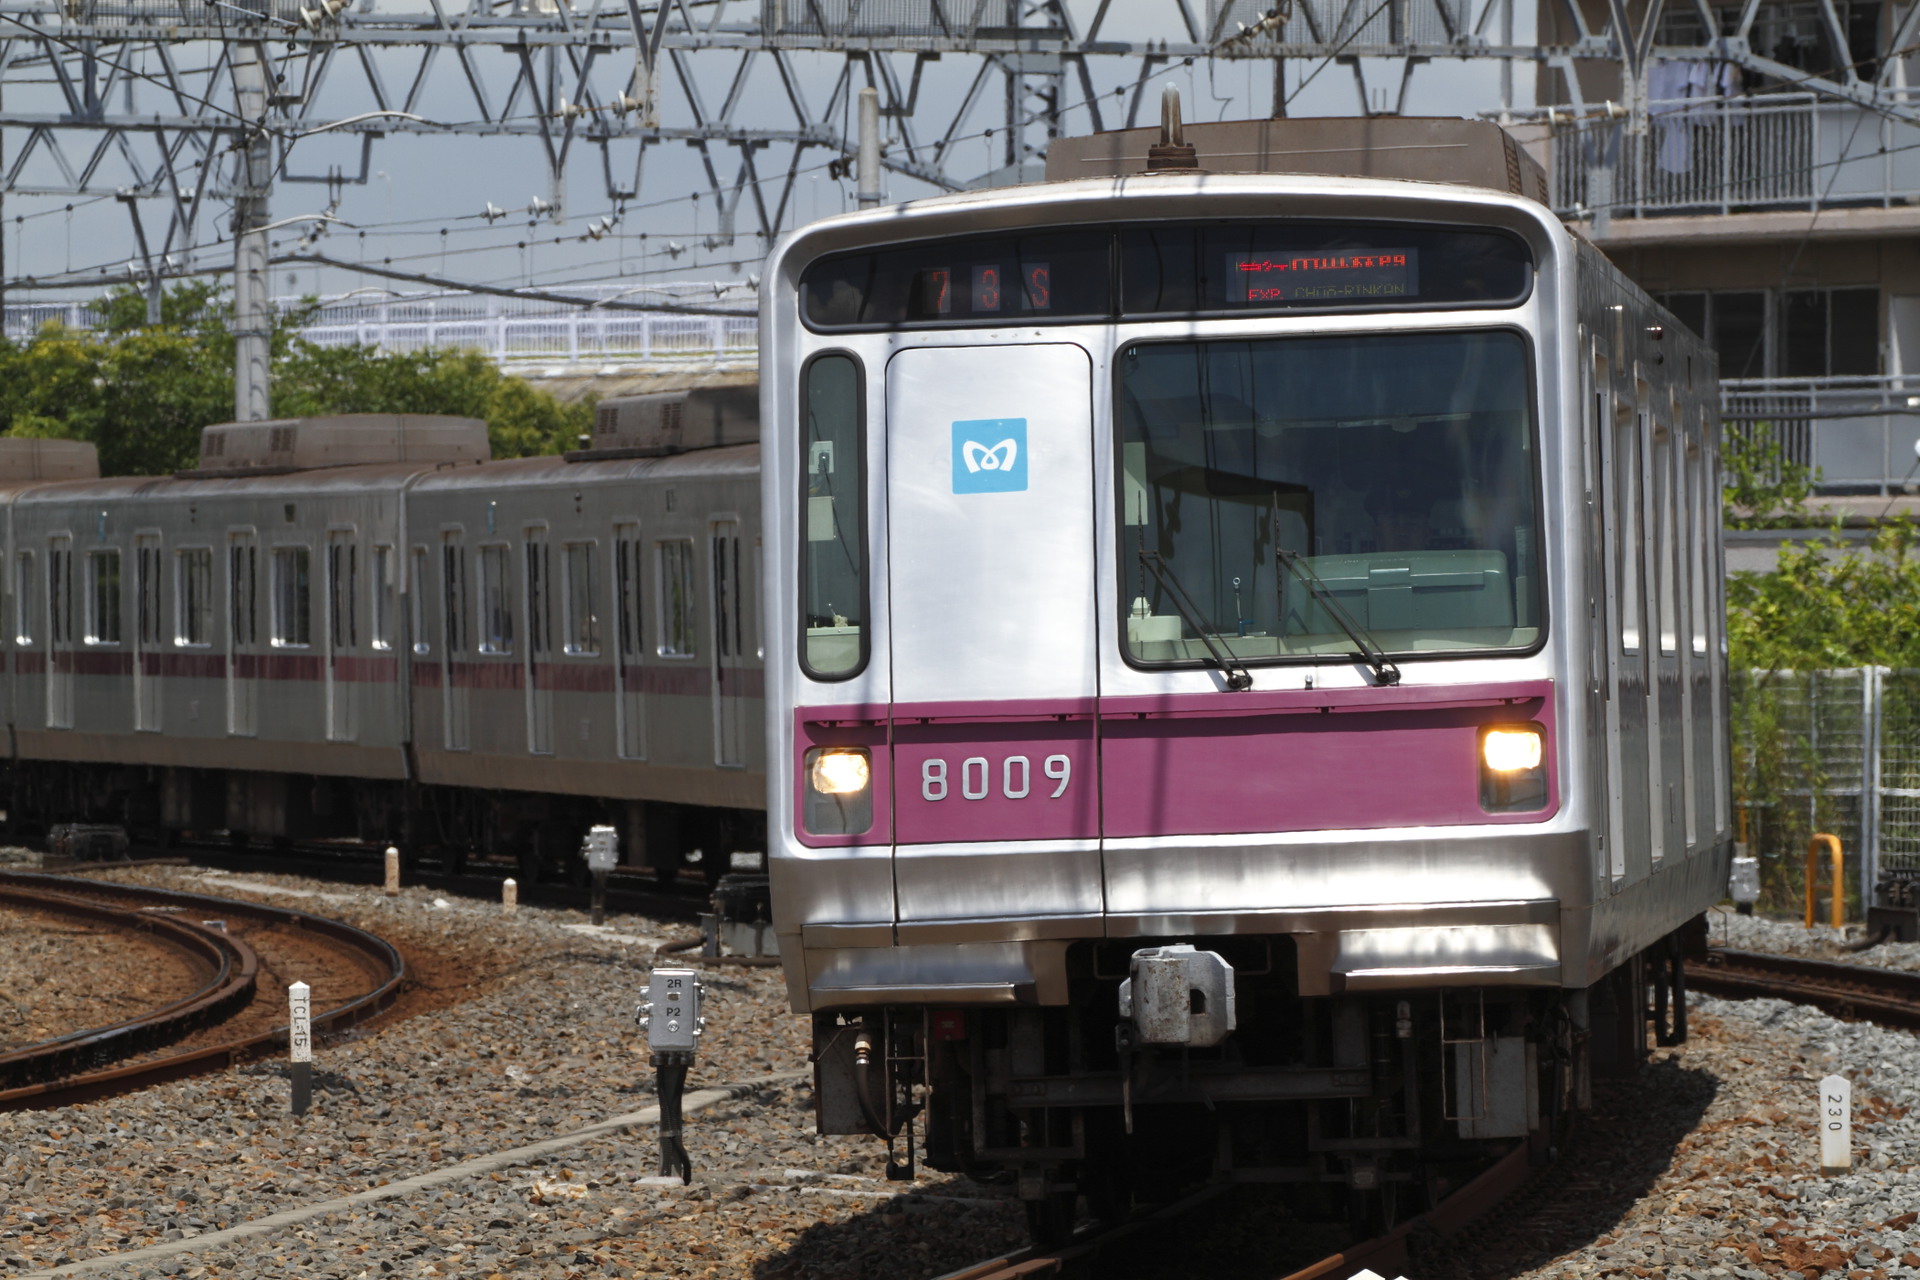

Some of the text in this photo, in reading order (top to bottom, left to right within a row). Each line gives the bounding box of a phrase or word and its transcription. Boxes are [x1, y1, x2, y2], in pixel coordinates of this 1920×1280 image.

[922, 754, 1071, 801] 8009
[667, 978, 682, 988] 2R
[666, 1007, 681, 1017] P2
[1828, 1094, 1843, 1131] 230
